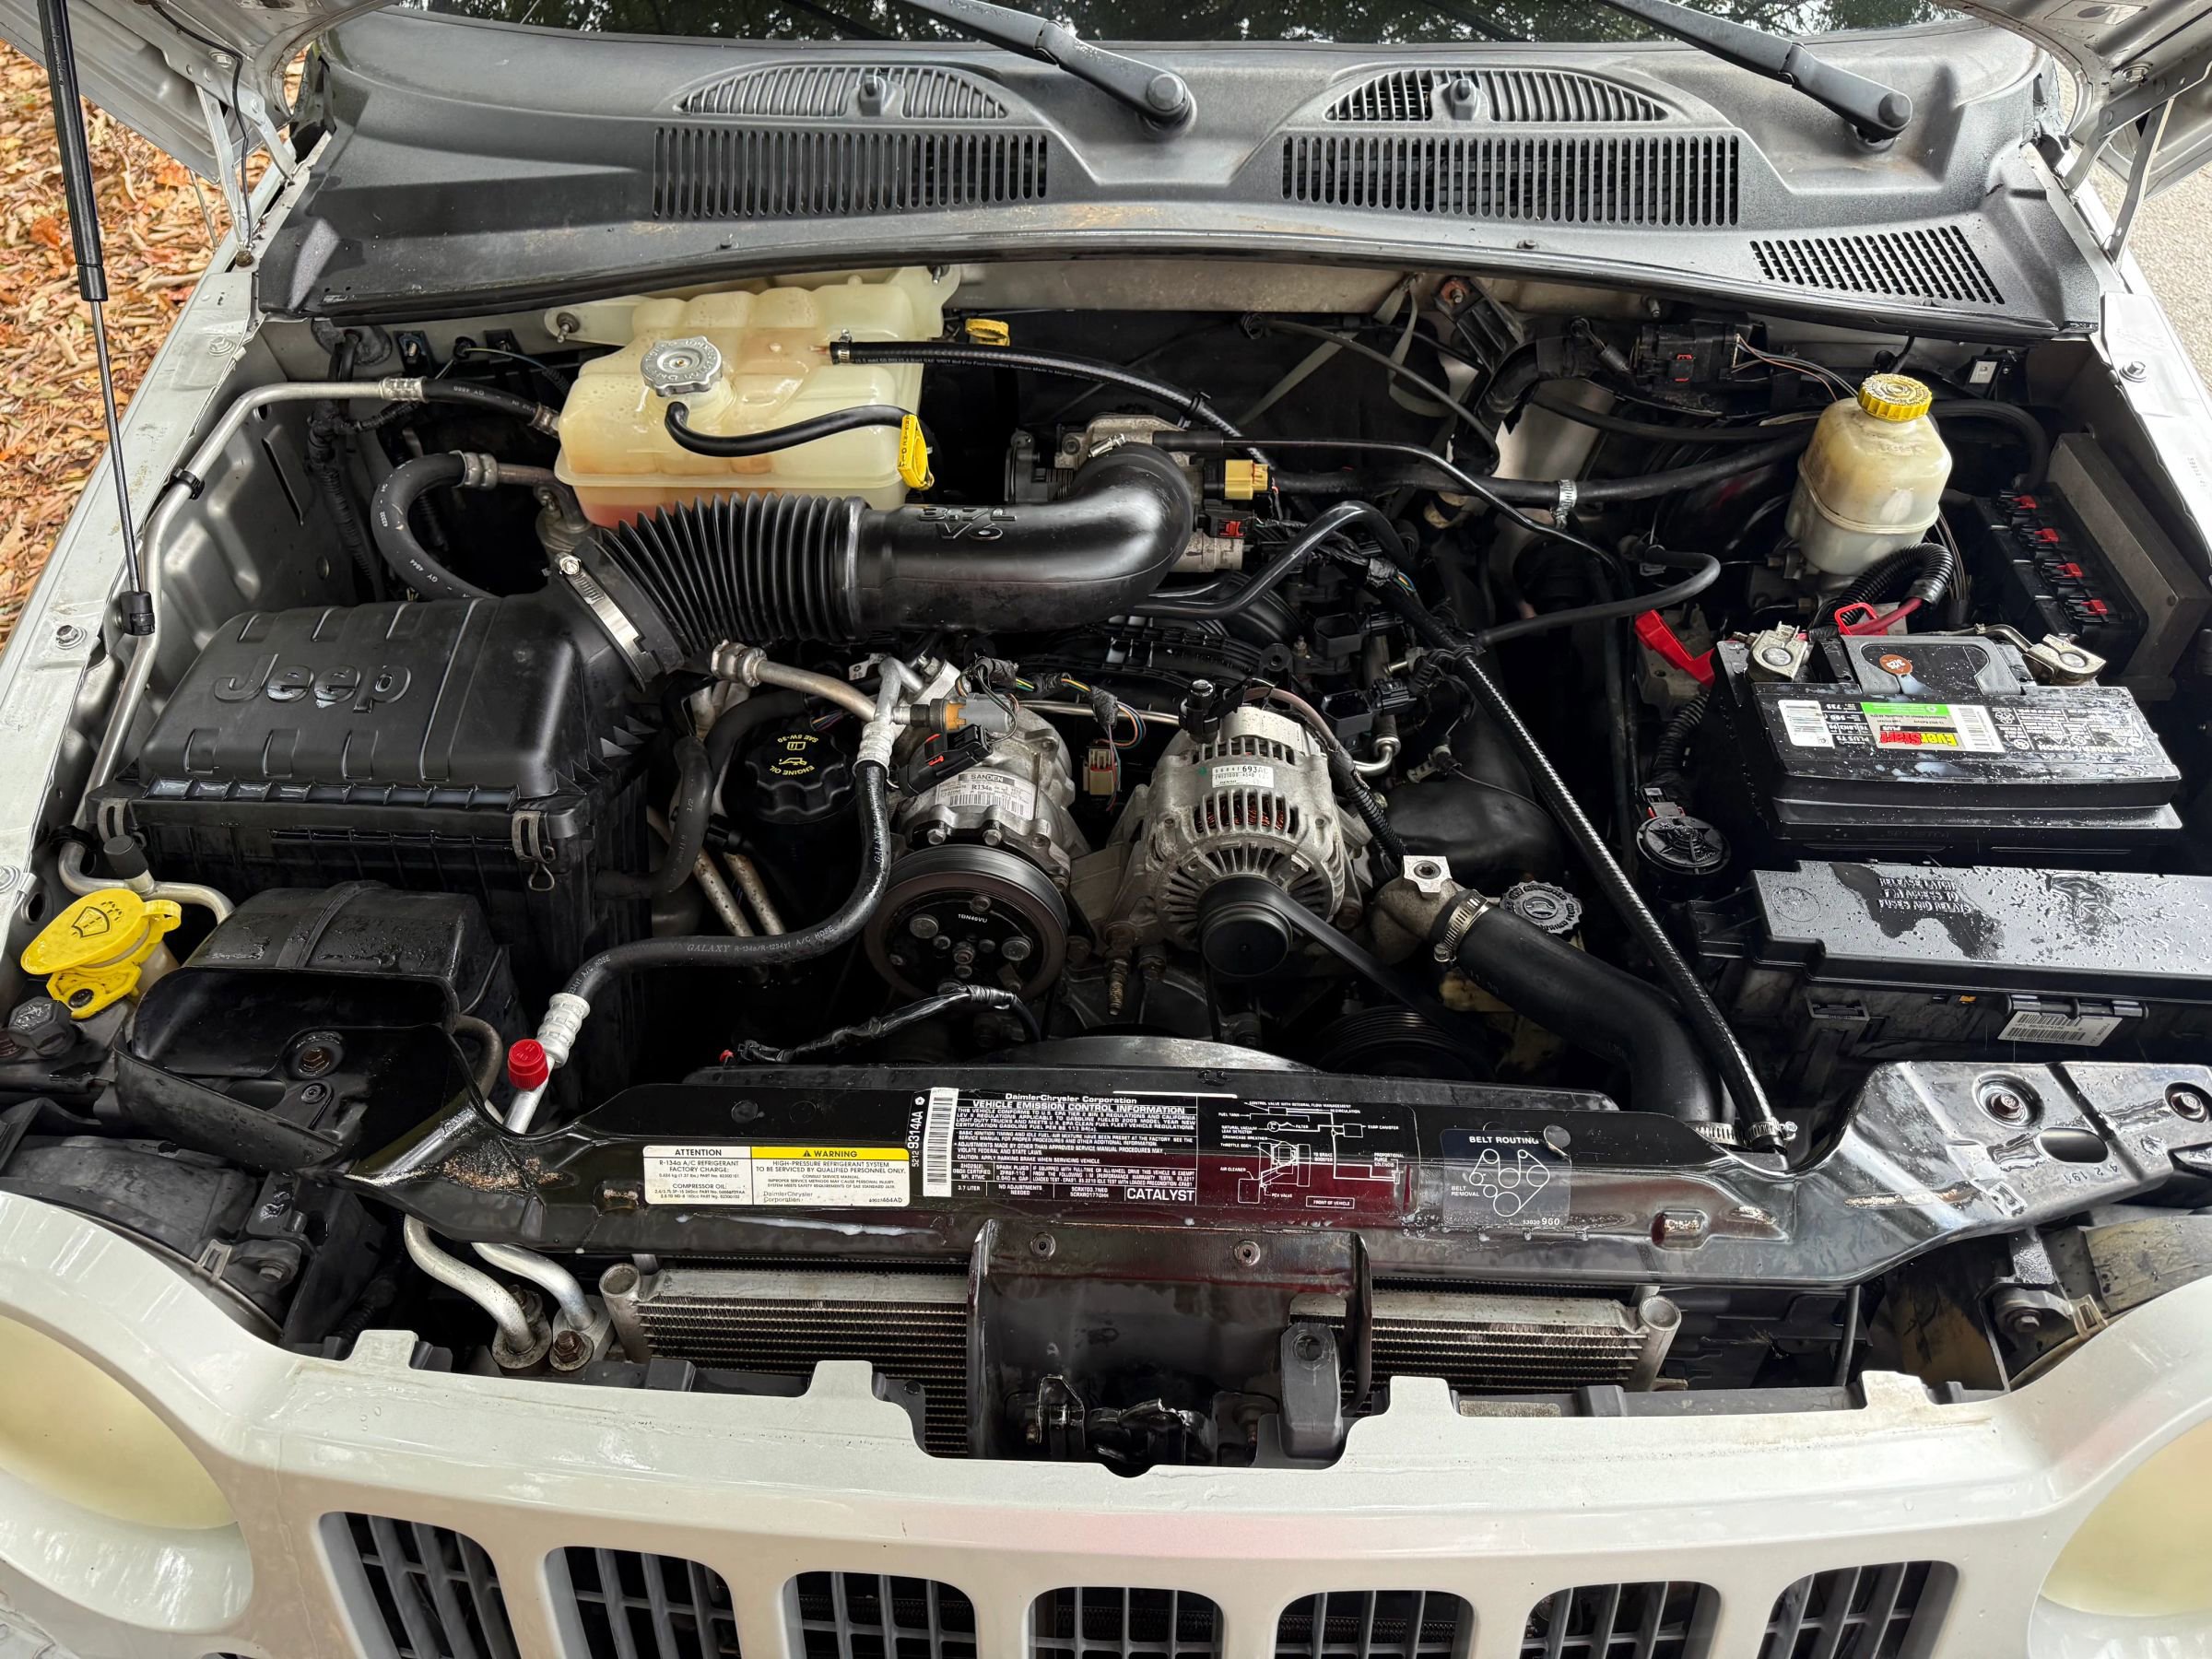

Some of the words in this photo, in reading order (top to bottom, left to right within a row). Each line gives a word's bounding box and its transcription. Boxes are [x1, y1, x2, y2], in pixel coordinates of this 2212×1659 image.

[918, 507, 1018, 522] 3.7L
[935, 522, 1004, 541] V6
[214, 653, 411, 714] Jeep
[777, 734, 802, 743] 5W-30
[803, 735, 819, 743] SAE
[1879, 732, 1958, 747] EverStart
[769, 765, 782, 774] OIL
[782, 765, 815, 776] ENGINE
[1005, 1093, 1079, 1102] DaimlerChrysler
[1082, 1096, 1137, 1104] Corporation
[1016, 1102, 1065, 1110] EMISSION
[1068, 1104, 1113, 1112] CONTROL
[1116, 1105, 1185, 1114] INFORMATION
[907, 1111, 924, 1149] 9314AA
[1495, 1137, 1539, 1145] ROUTING
[1127, 1188, 1194, 1201] CATALYST
